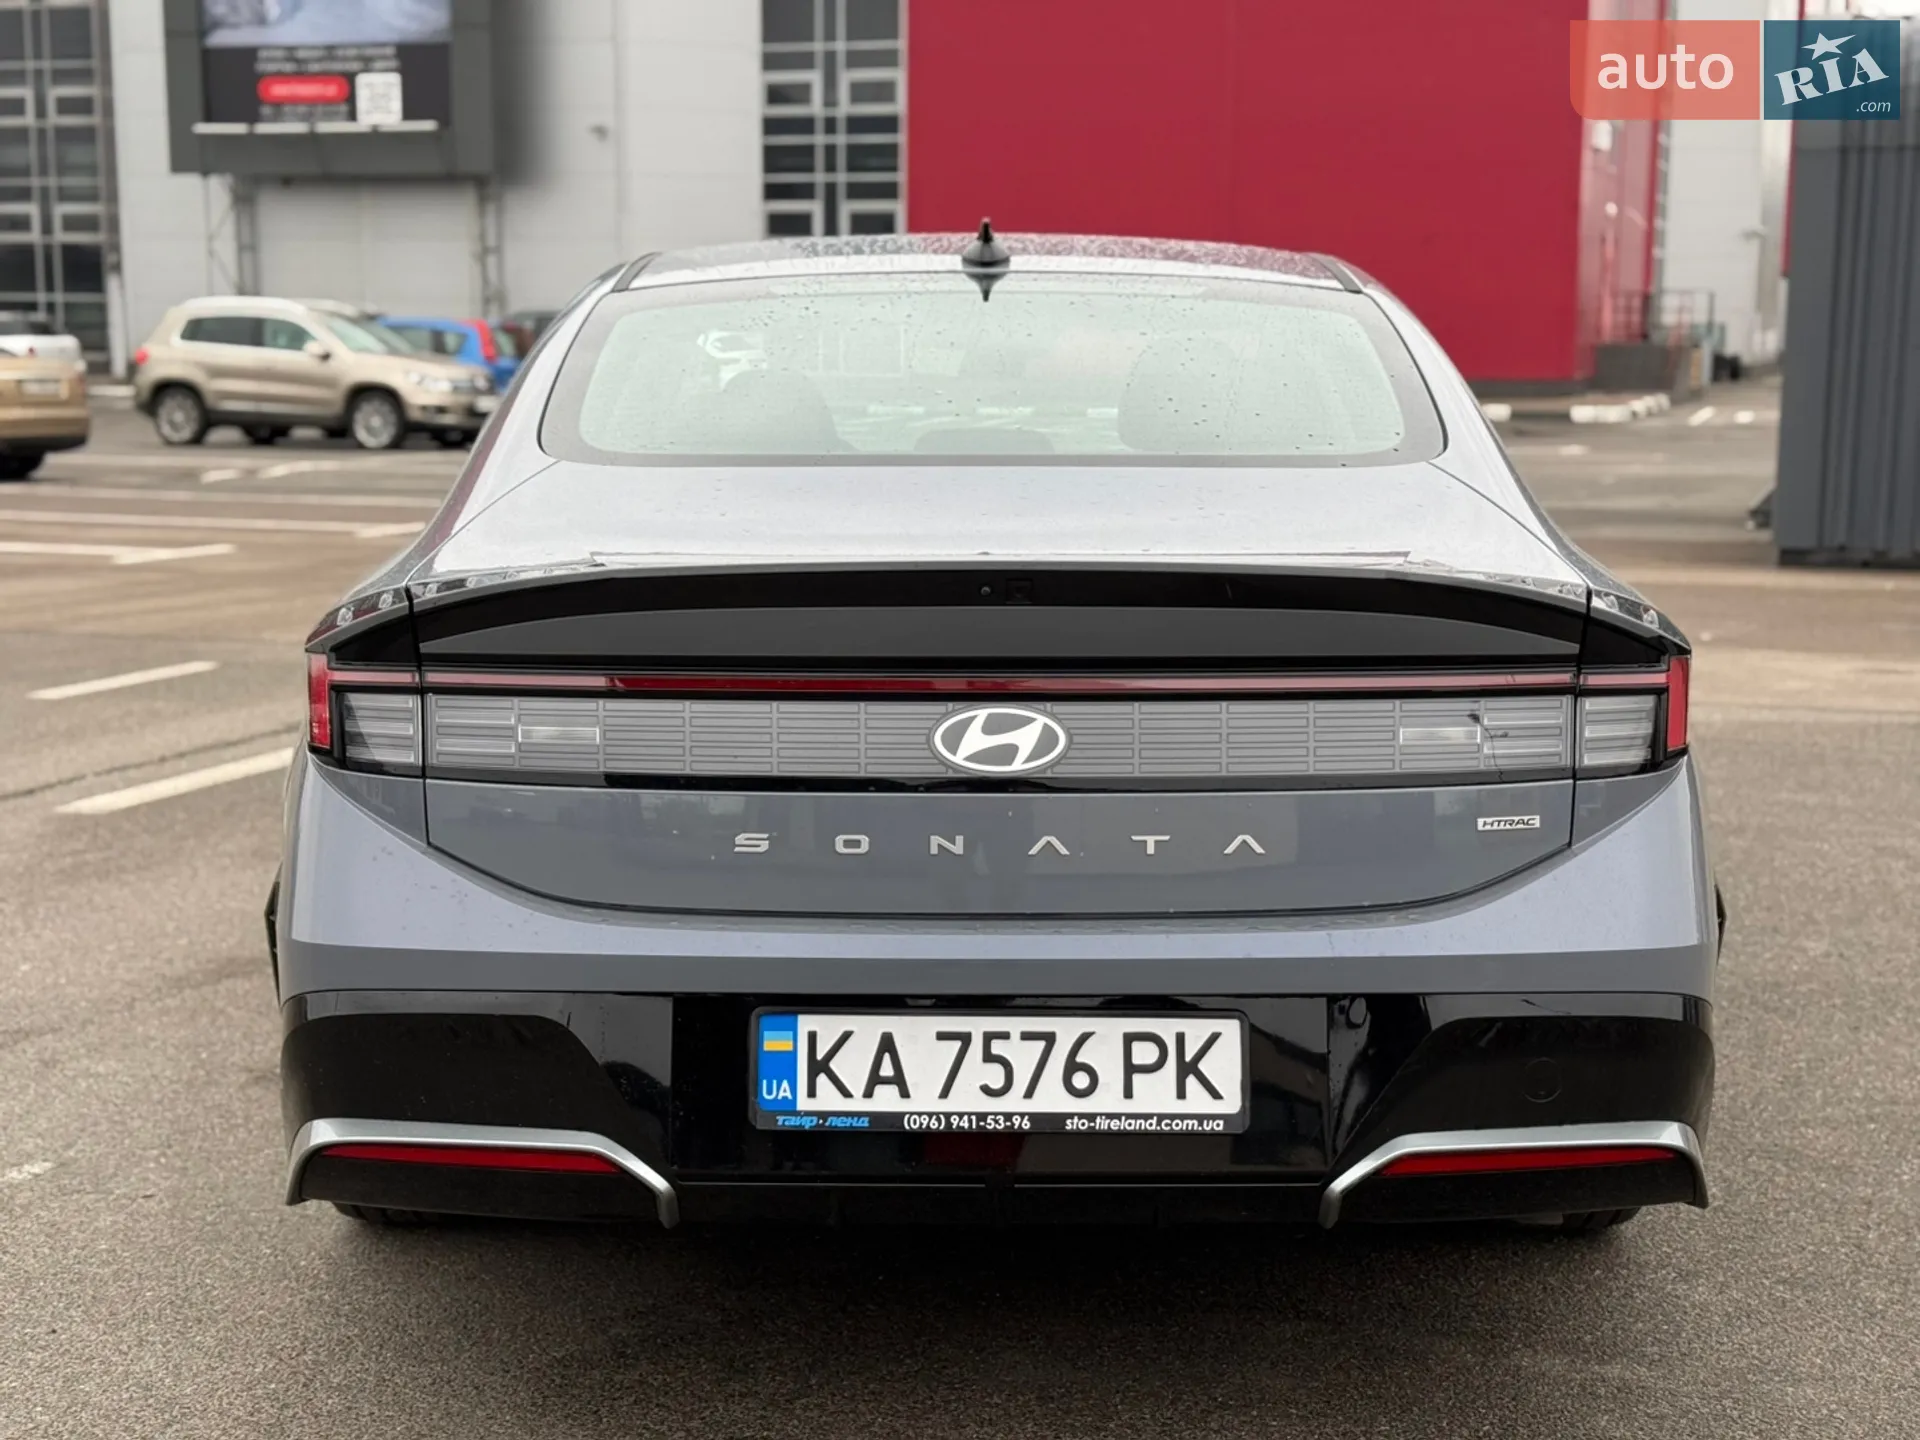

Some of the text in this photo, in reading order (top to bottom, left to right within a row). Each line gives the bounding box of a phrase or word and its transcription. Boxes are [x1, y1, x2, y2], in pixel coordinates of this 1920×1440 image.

[1481, 817, 1538, 829] HTRAC
[732, 831, 1267, 856] SONATA
[806, 1029, 1225, 1101] KA 7576 PK
[762, 1079, 793, 1100] UA
[903, 1114, 1031, 1131] (096) 941-53-96
[1064, 1115, 1225, 1131] sto-tireland.com.ua
